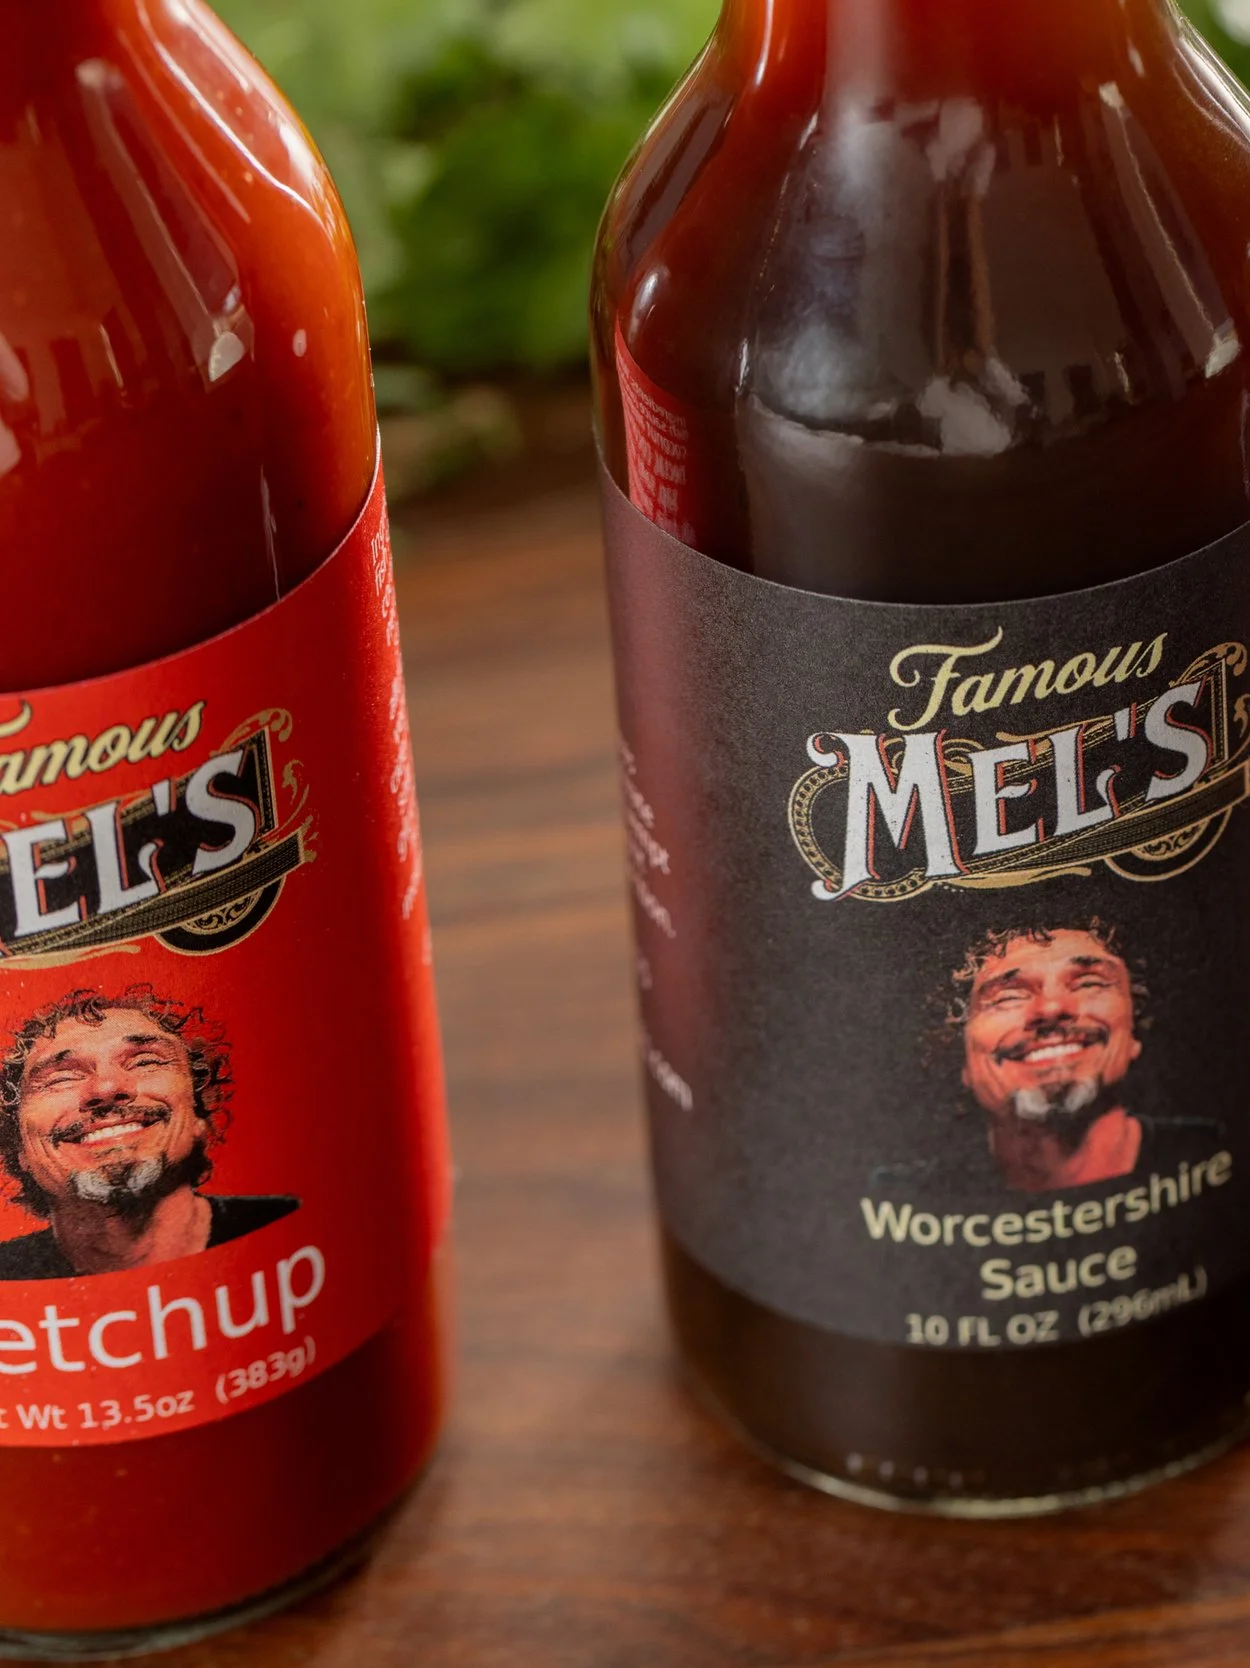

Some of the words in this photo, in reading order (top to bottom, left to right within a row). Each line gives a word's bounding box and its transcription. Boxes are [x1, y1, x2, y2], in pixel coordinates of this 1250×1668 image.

[888, 625, 1168, 732] Famous
[0, 700, 206, 795] amous
[806, 681, 1213, 901] MEL'S
[0, 750, 258, 940] EL'S
[860, 1149, 1233, 1247] Worcestershire
[0, 1244, 326, 1374] etchup
[979, 1243, 1137, 1301] Sauce
[905, 1312, 949, 1346] 10
[957, 1315, 1002, 1347] FL
[1006, 1310, 1060, 1345] OZ
[16, 1404, 68, 1430] Wt
[78, 1390, 195, 1431] 13.5oz
[214, 1335, 317, 1404] (383g)
